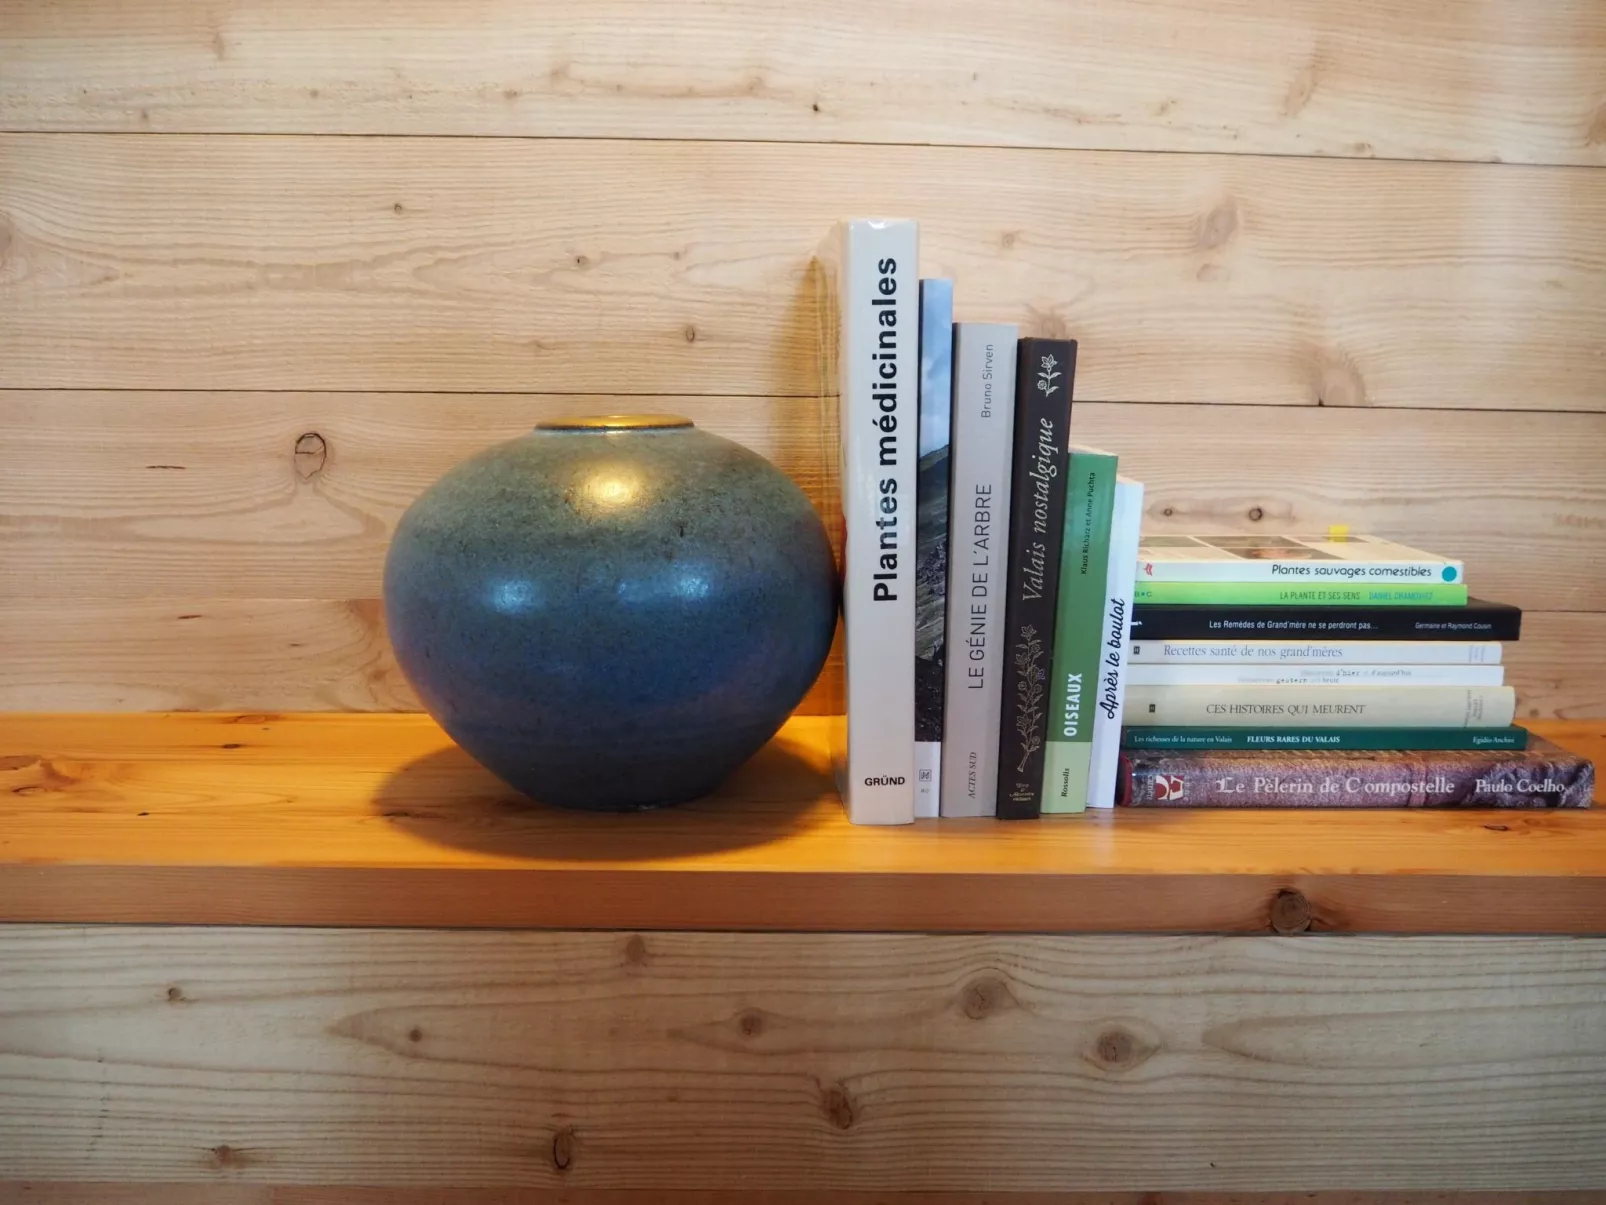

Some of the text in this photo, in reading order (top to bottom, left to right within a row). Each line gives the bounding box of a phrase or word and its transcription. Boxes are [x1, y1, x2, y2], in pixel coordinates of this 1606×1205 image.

[981, 344, 994, 418] Bruno Sirven
[872, 257, 898, 602] Plantes médicinales
[1087, 472, 1096, 496] Puchta
[1022, 418, 1060, 602] Valais nostalgique
[1085, 518, 1092, 526] et
[1082, 527, 1091, 553] Richarz
[1080, 555, 1088, 575] Klaus
[1271, 564, 1432, 579] Plantes sauvages comestibles
[965, 484, 992, 689] LE GÉNIE DE L'ARBRE
[1280, 591, 1360, 600] LA PLANTE ET SES SENS
[1209, 620, 1222, 629] Les
[1256, 620, 1265, 629] de
[1267, 620, 1307, 630] Grand'mère
[1318, 622, 1327, 630] se
[1328, 621, 1357, 632] perdront
[1447, 622, 1473, 631] Raymond
[1099, 597, 1125, 720] Après le boulot
[1164, 645, 1344, 660] Recettes santé de nos grand'mères
[1063, 673, 1083, 737] OISEAUX
[1206, 704, 1367, 715] CES HISTOIRES QUI MEURENT
[1134, 735, 1145, 743] Les
[1145, 735, 1171, 743] richesses
[1171, 735, 1179, 743] de
[1180, 735, 1186, 743] la
[1215, 735, 1233, 743] Valais
[1247, 736, 1341, 744] FLEURS RARES DU VALAIS
[864, 774, 906, 787] GRÜND
[967, 752, 978, 799] ACTES SUD
[1061, 767, 1070, 798] Rossolis
[1214, 775, 1456, 797] Le Pèlerin de Compostelle
[1474, 778, 1565, 794] Paulo Coelho
